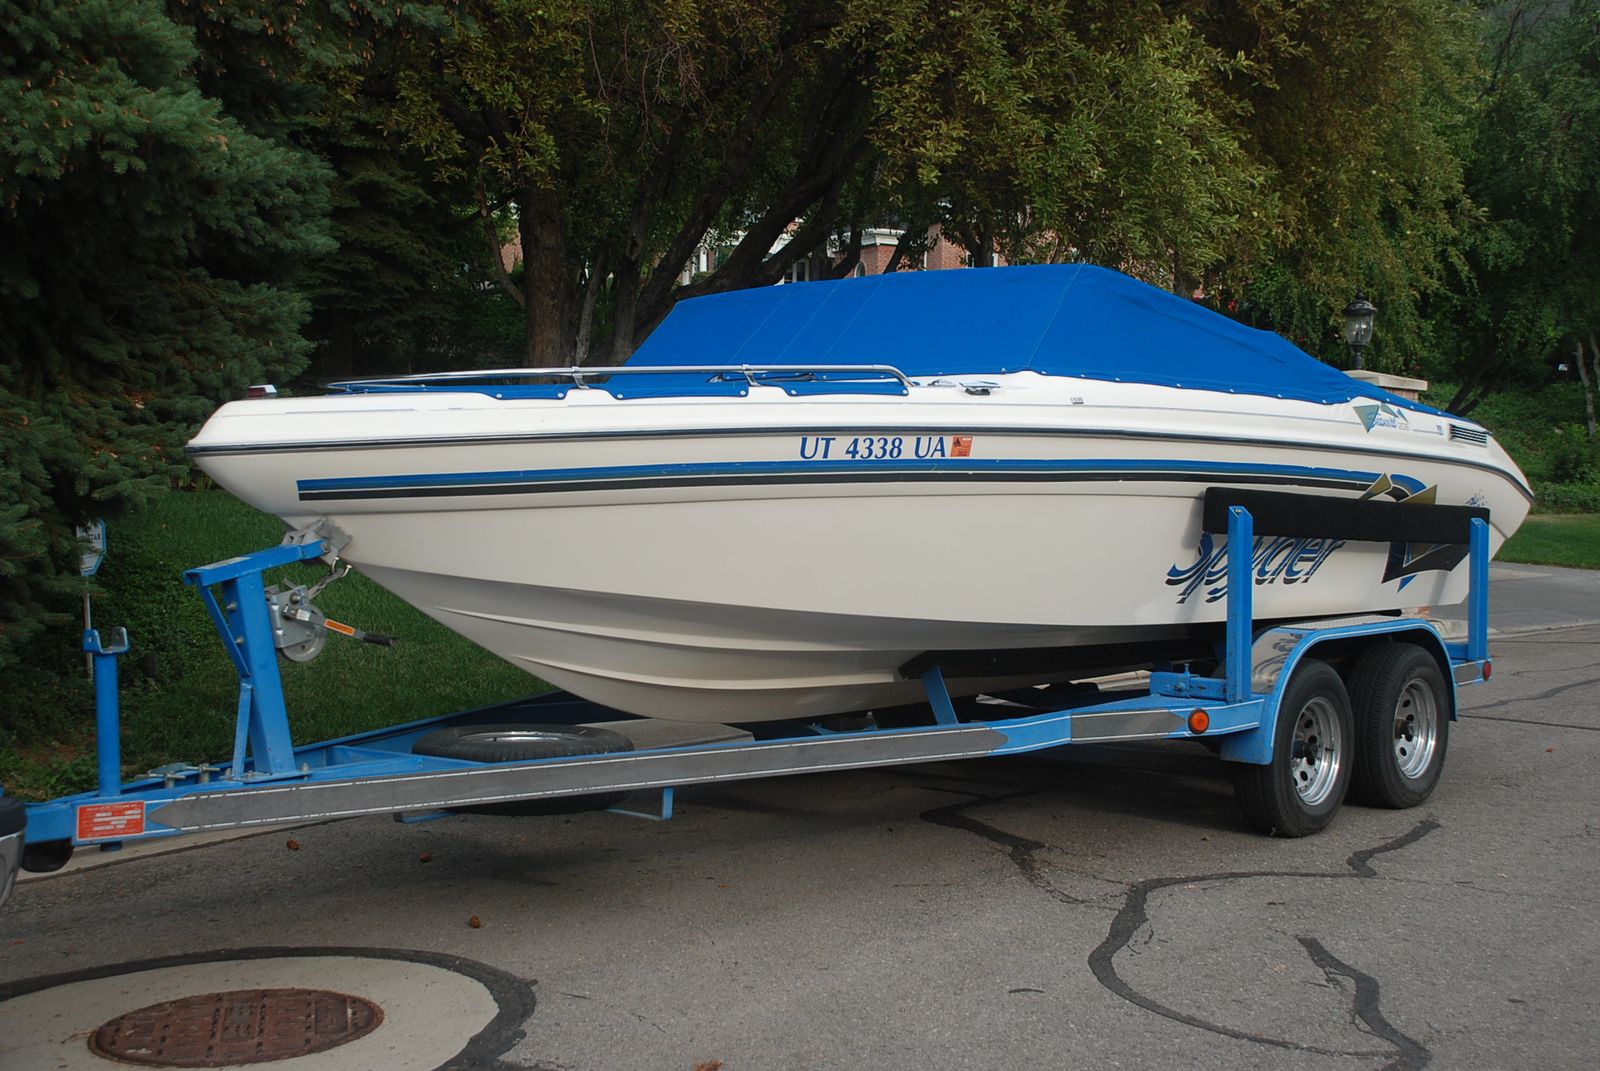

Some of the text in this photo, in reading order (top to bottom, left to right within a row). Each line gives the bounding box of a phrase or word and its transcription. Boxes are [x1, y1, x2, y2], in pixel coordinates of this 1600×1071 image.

[800, 436, 836, 460] UT
[845, 437, 903, 459] 4338
[914, 436, 946, 459] UA
